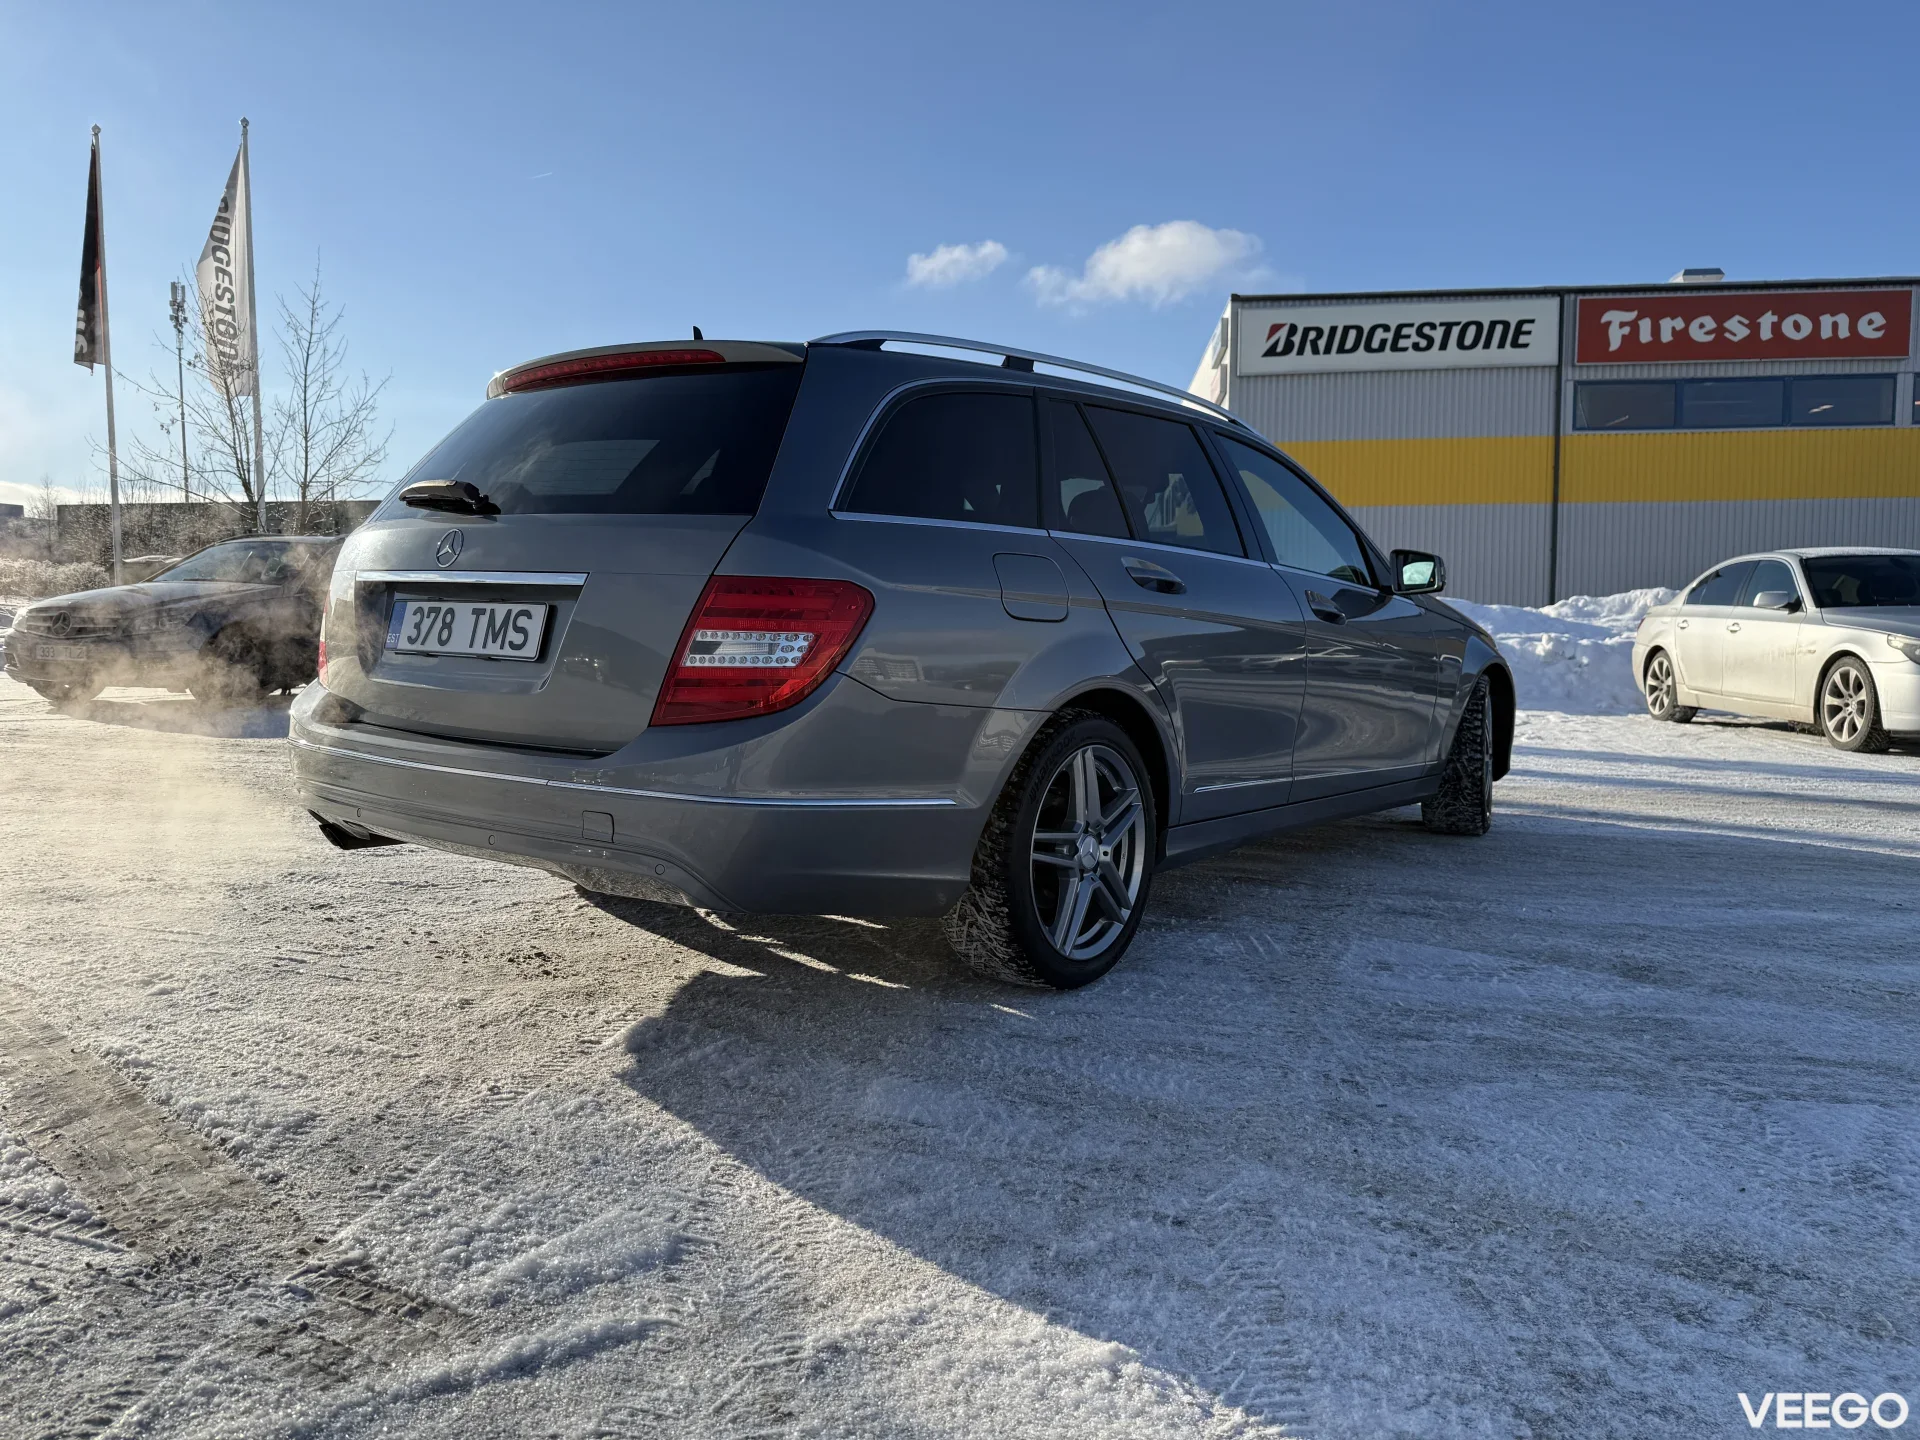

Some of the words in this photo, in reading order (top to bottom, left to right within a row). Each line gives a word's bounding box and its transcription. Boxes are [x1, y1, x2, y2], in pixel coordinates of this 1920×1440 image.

[209, 196, 240, 375] IDGESTON
[1261, 318, 1536, 358] BRIDGESTONE
[1600, 309, 1887, 352] Firestone
[386, 633, 400, 643] EST
[407, 606, 455, 647] 378
[469, 607, 533, 651] TMS
[40, 646, 55, 658] 333
